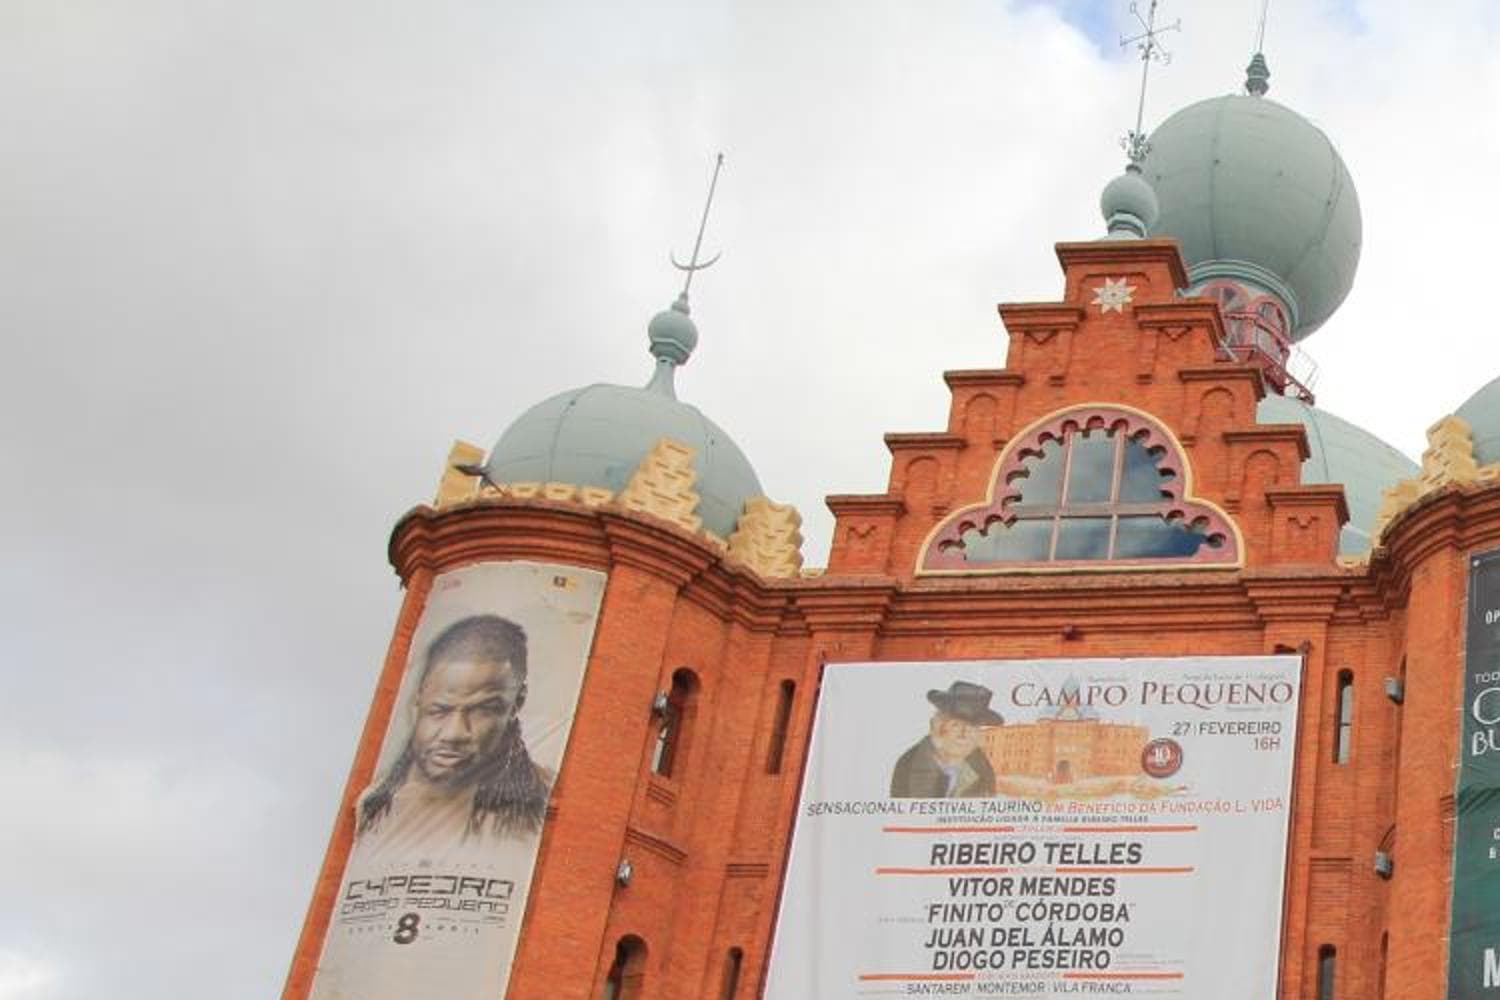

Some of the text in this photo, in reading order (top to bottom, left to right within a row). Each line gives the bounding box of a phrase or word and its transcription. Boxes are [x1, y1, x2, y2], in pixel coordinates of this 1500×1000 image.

[1172, 722, 1282, 735] 27 FEVEREIRO
[1253, 738, 1281, 750] 16H
[807, 801, 903, 817] SENSACIONAL
[909, 802, 976, 815] FESTIVAL
[981, 801, 1042, 814] TAURINO
[1251, 798, 1283, 812] VIDA
[930, 842, 1143, 865] RIBEIRO TELLES
[949, 877, 1116, 897] VITOR MENDES
[342, 898, 509, 914] CAMPO PEQUENO
[393, 912, 421, 945] 8
[925, 922, 1124, 948] JUAN DEL ÁLAMO
[932, 950, 1005, 970] DIOGO
[1011, 950, 1110, 970] PESEIRO
[977, 982, 1045, 994] MONTEMOR
[1054, 982, 1079, 993] VILA
